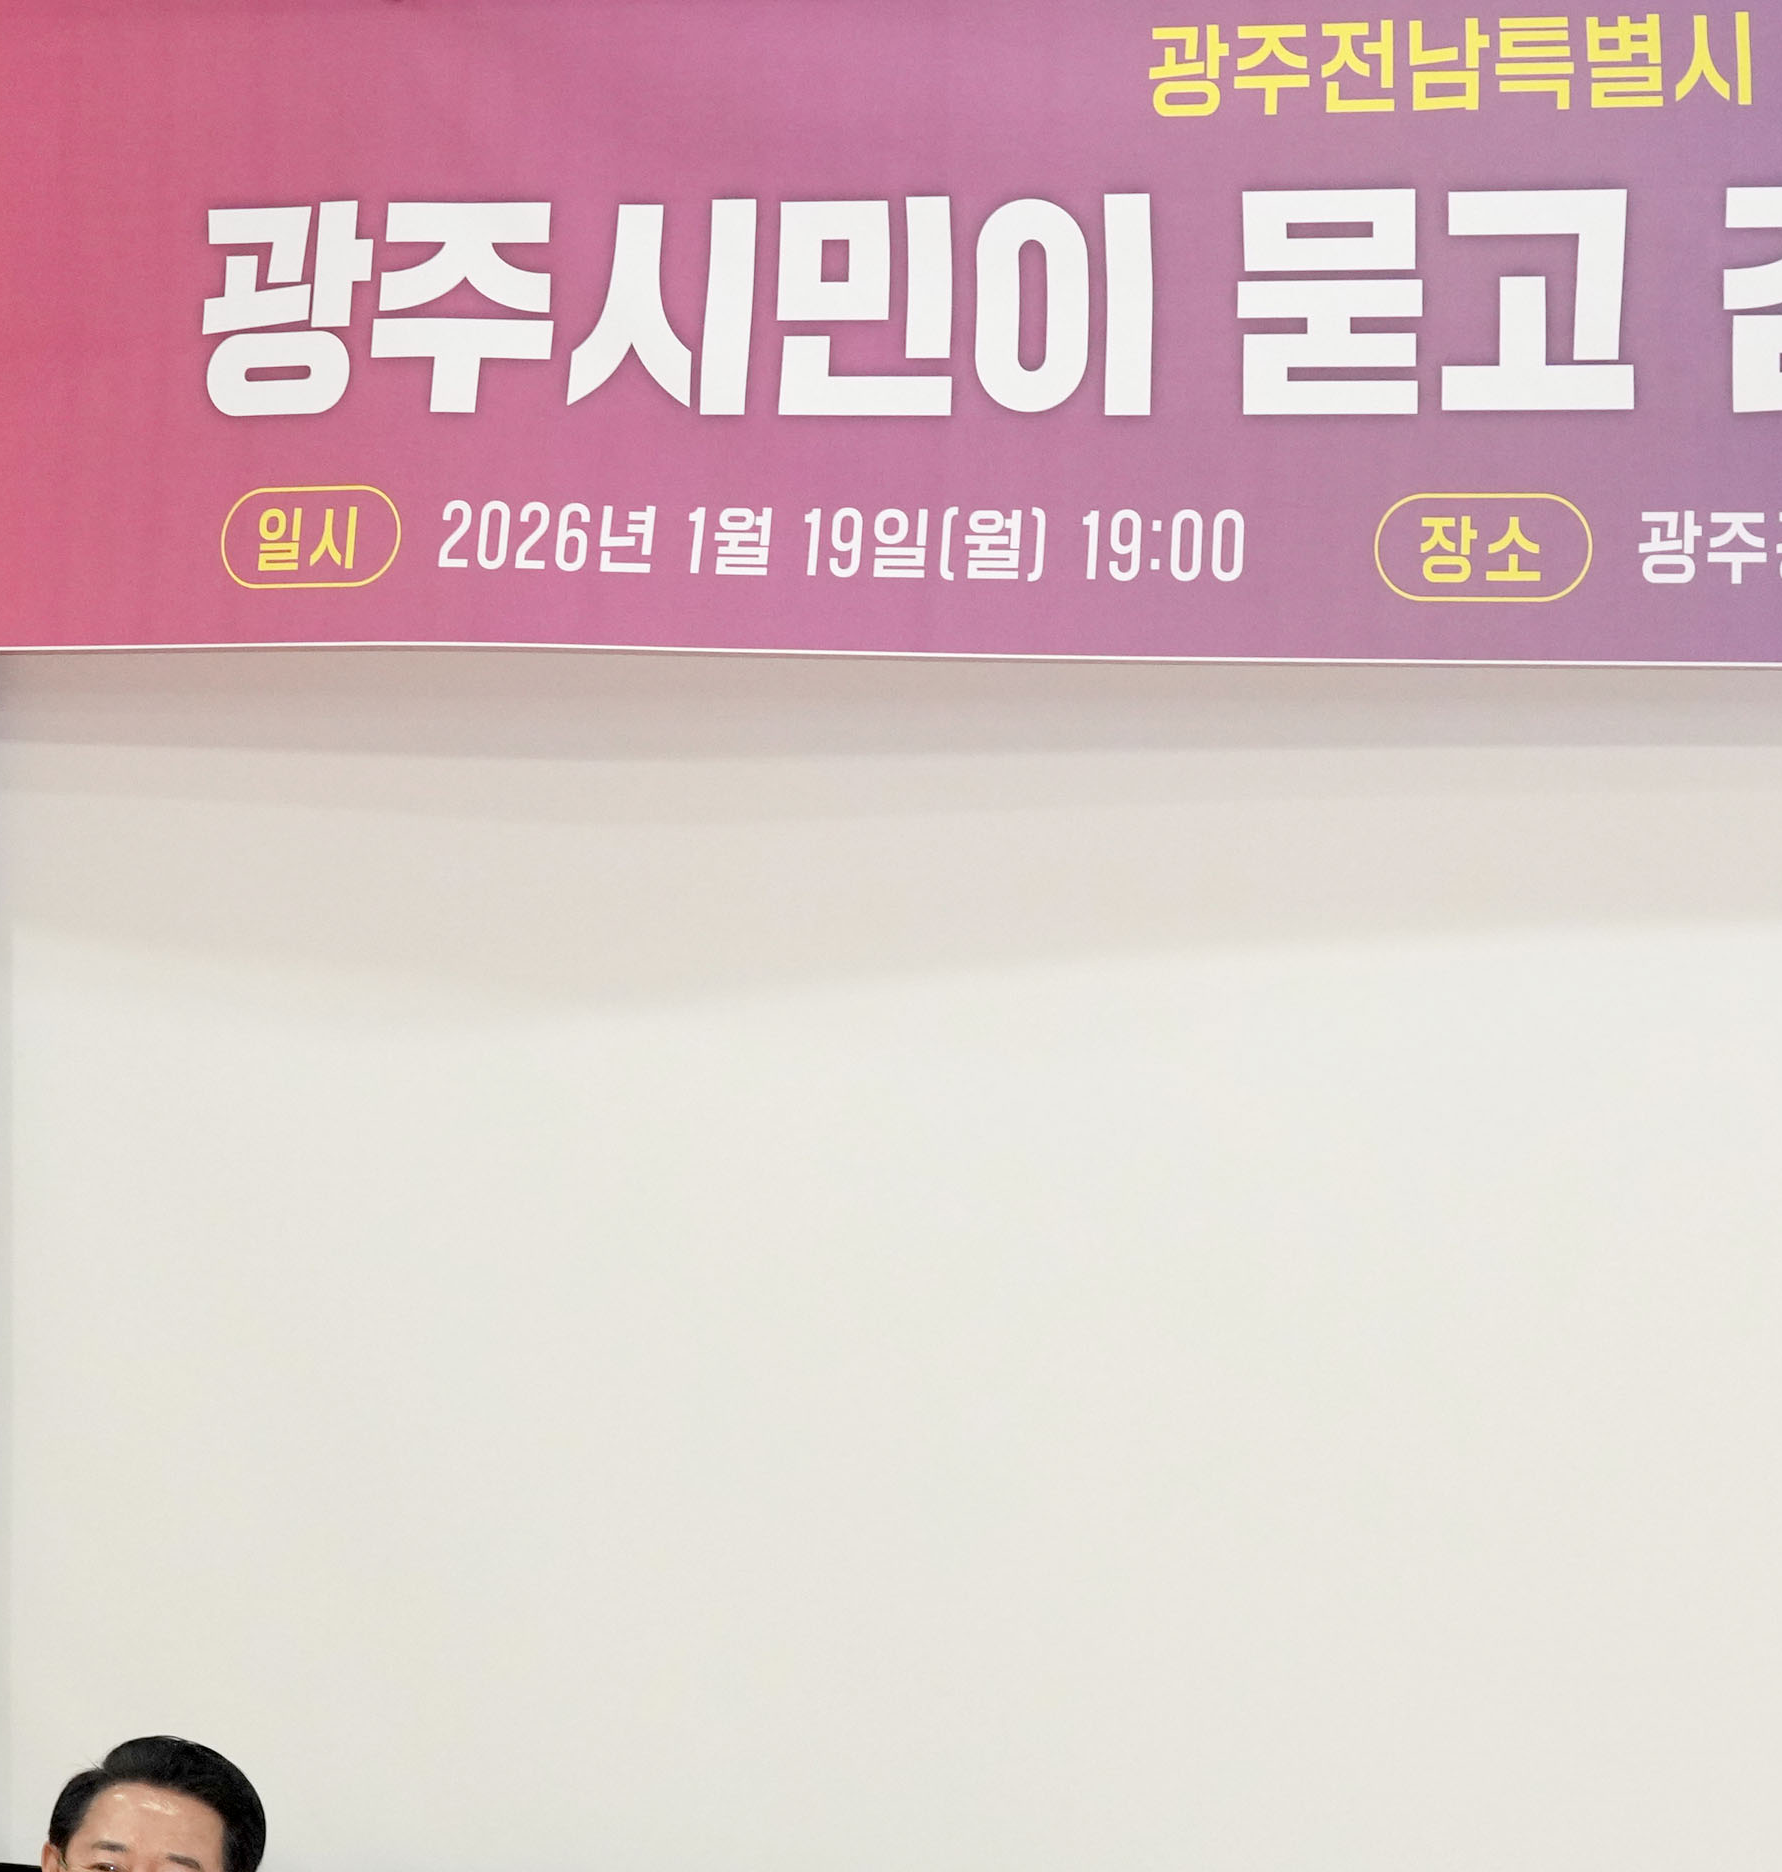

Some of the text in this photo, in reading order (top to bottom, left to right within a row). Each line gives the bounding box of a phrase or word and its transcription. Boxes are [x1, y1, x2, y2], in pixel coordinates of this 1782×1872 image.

[1148, 11, 1753, 118] 광주전남특별시
[201, 192, 1155, 418] 광주시민이
[1236, 187, 1636, 416] 묻고
[257, 506, 357, 571] 일시
[437, 499, 1246, 583] 2026년 1월 19일(월) 19:00
[1420, 515, 1542, 583] 장소
